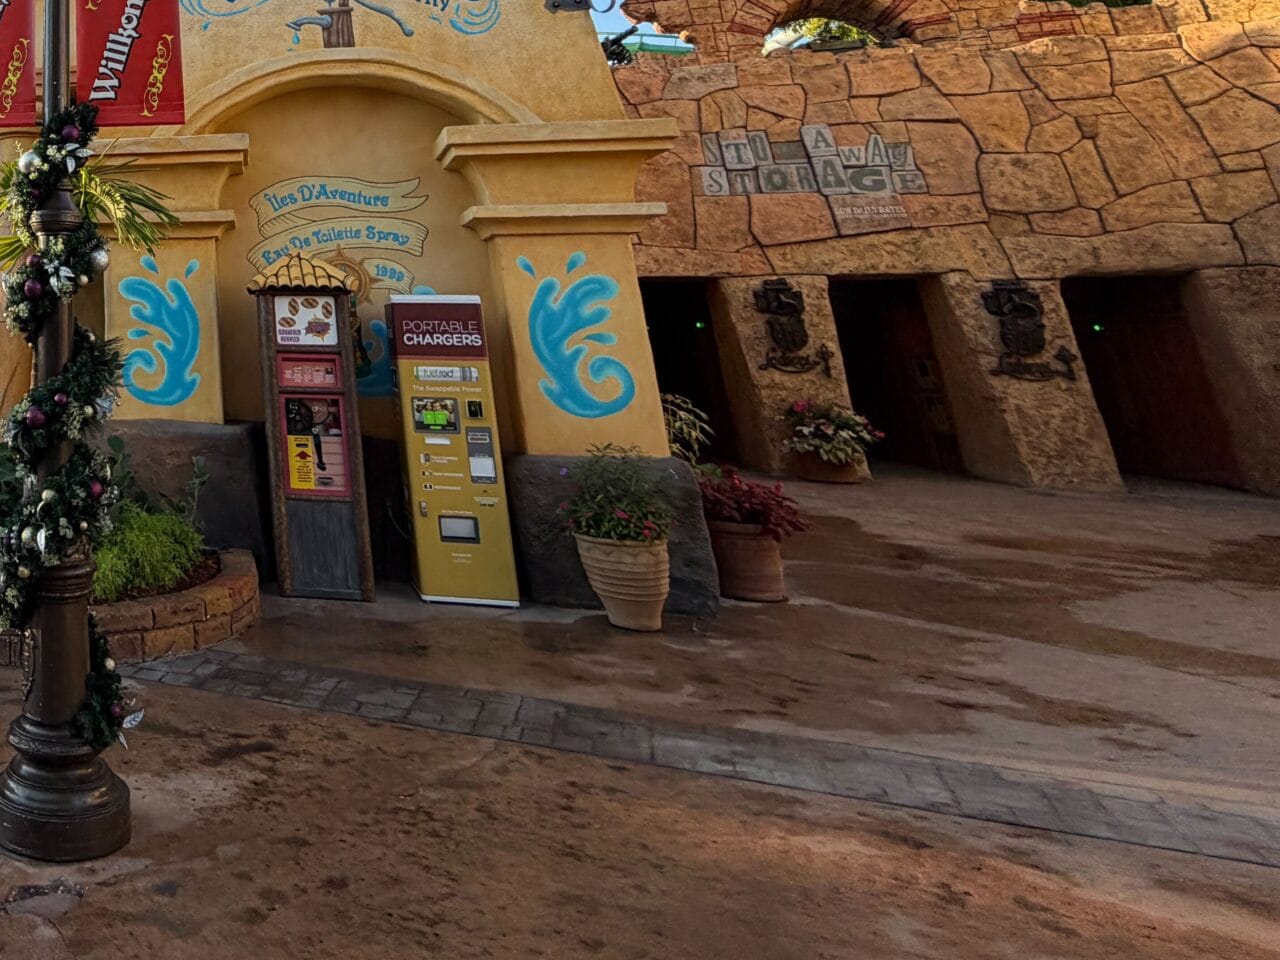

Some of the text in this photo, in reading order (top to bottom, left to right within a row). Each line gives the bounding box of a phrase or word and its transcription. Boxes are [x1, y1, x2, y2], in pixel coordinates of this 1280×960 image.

[706, 159, 925, 193] STORAGE
[297, 183, 389, 208] D'Aventure
[262, 225, 410, 265] Eau De Toilette Spray
[402, 320, 479, 333] PORTABLE
[403, 333, 482, 346] CHARGERS
